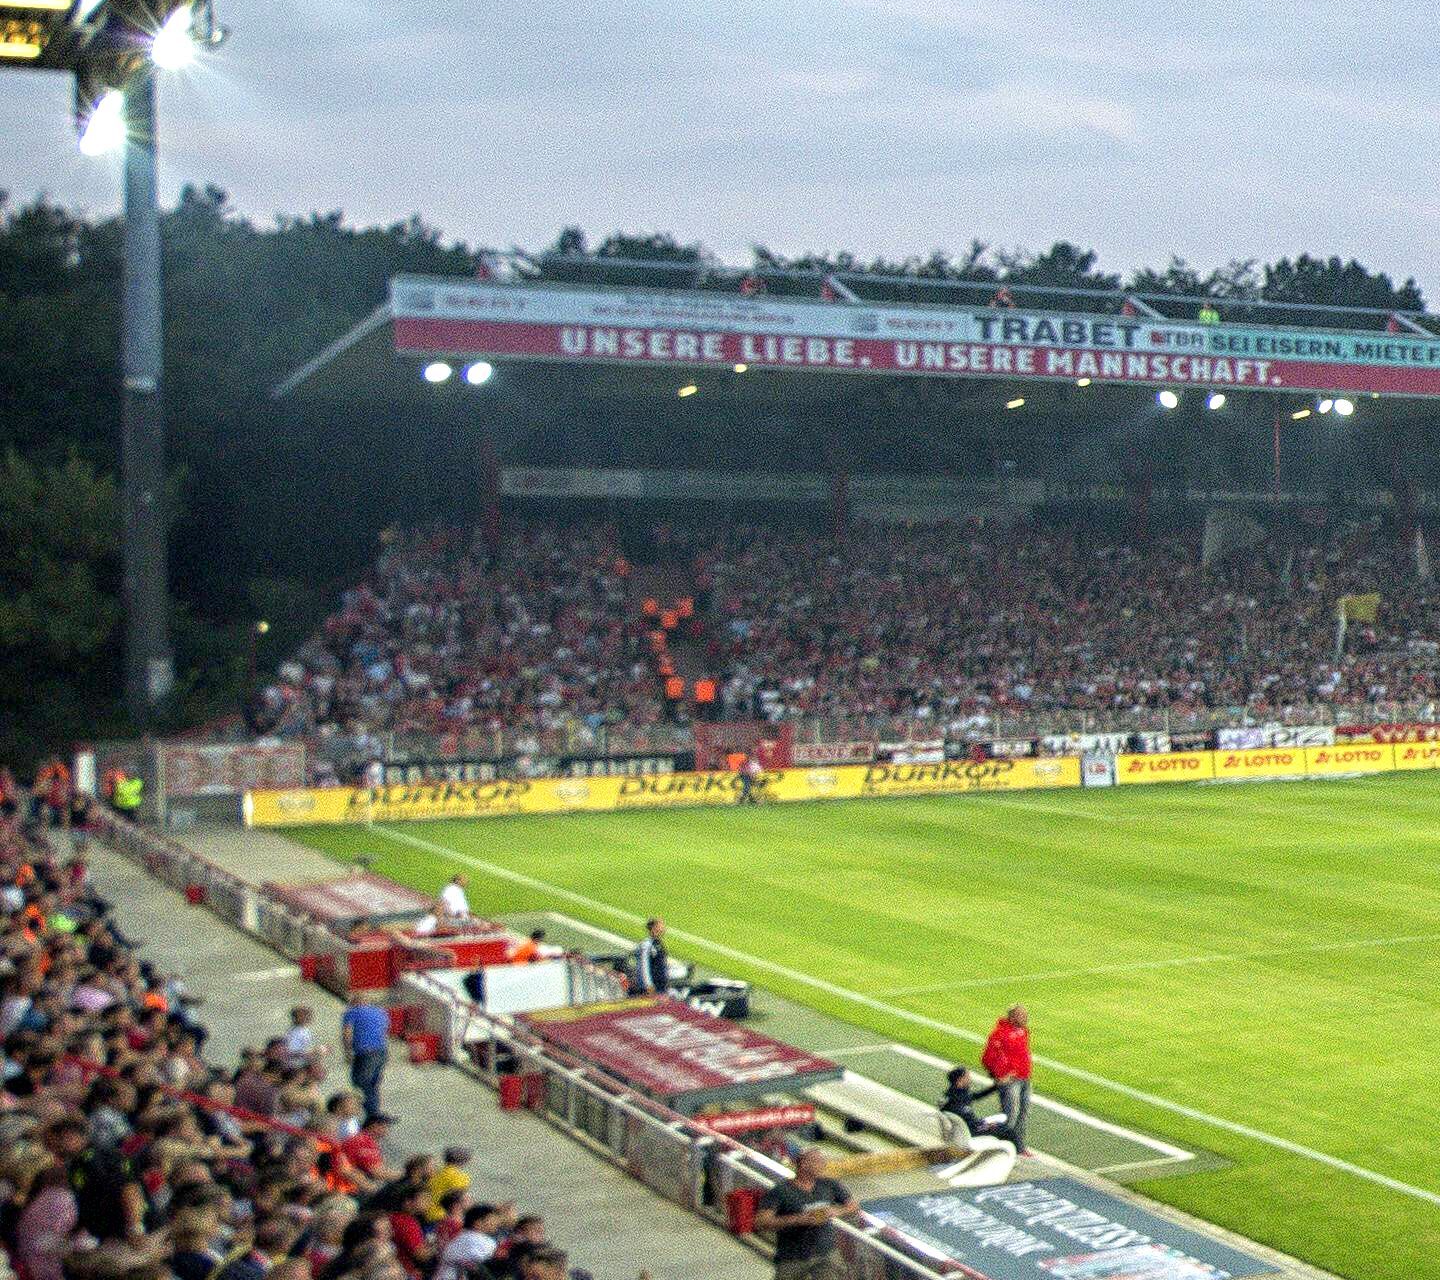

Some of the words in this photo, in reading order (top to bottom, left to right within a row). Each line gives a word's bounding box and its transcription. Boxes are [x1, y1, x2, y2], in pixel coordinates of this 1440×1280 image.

[972, 317, 1141, 347] TRABET
[562, 327, 723, 359] UNSERE
[742, 336, 871, 366] LIEBE.
[896, 342, 1034, 373] UNSERE
[1047, 351, 1281, 386] MANNSCHAFT.
[1212, 334, 1249, 352] SEI
[1263, 337, 1347, 359] EISERN,
[1354, 342, 1427, 361] MIETE
[1149, 758, 1200, 773] LOTTO
[1244, 754, 1293, 768] LOTTO
[1334, 751, 1383, 763] LOTTO
